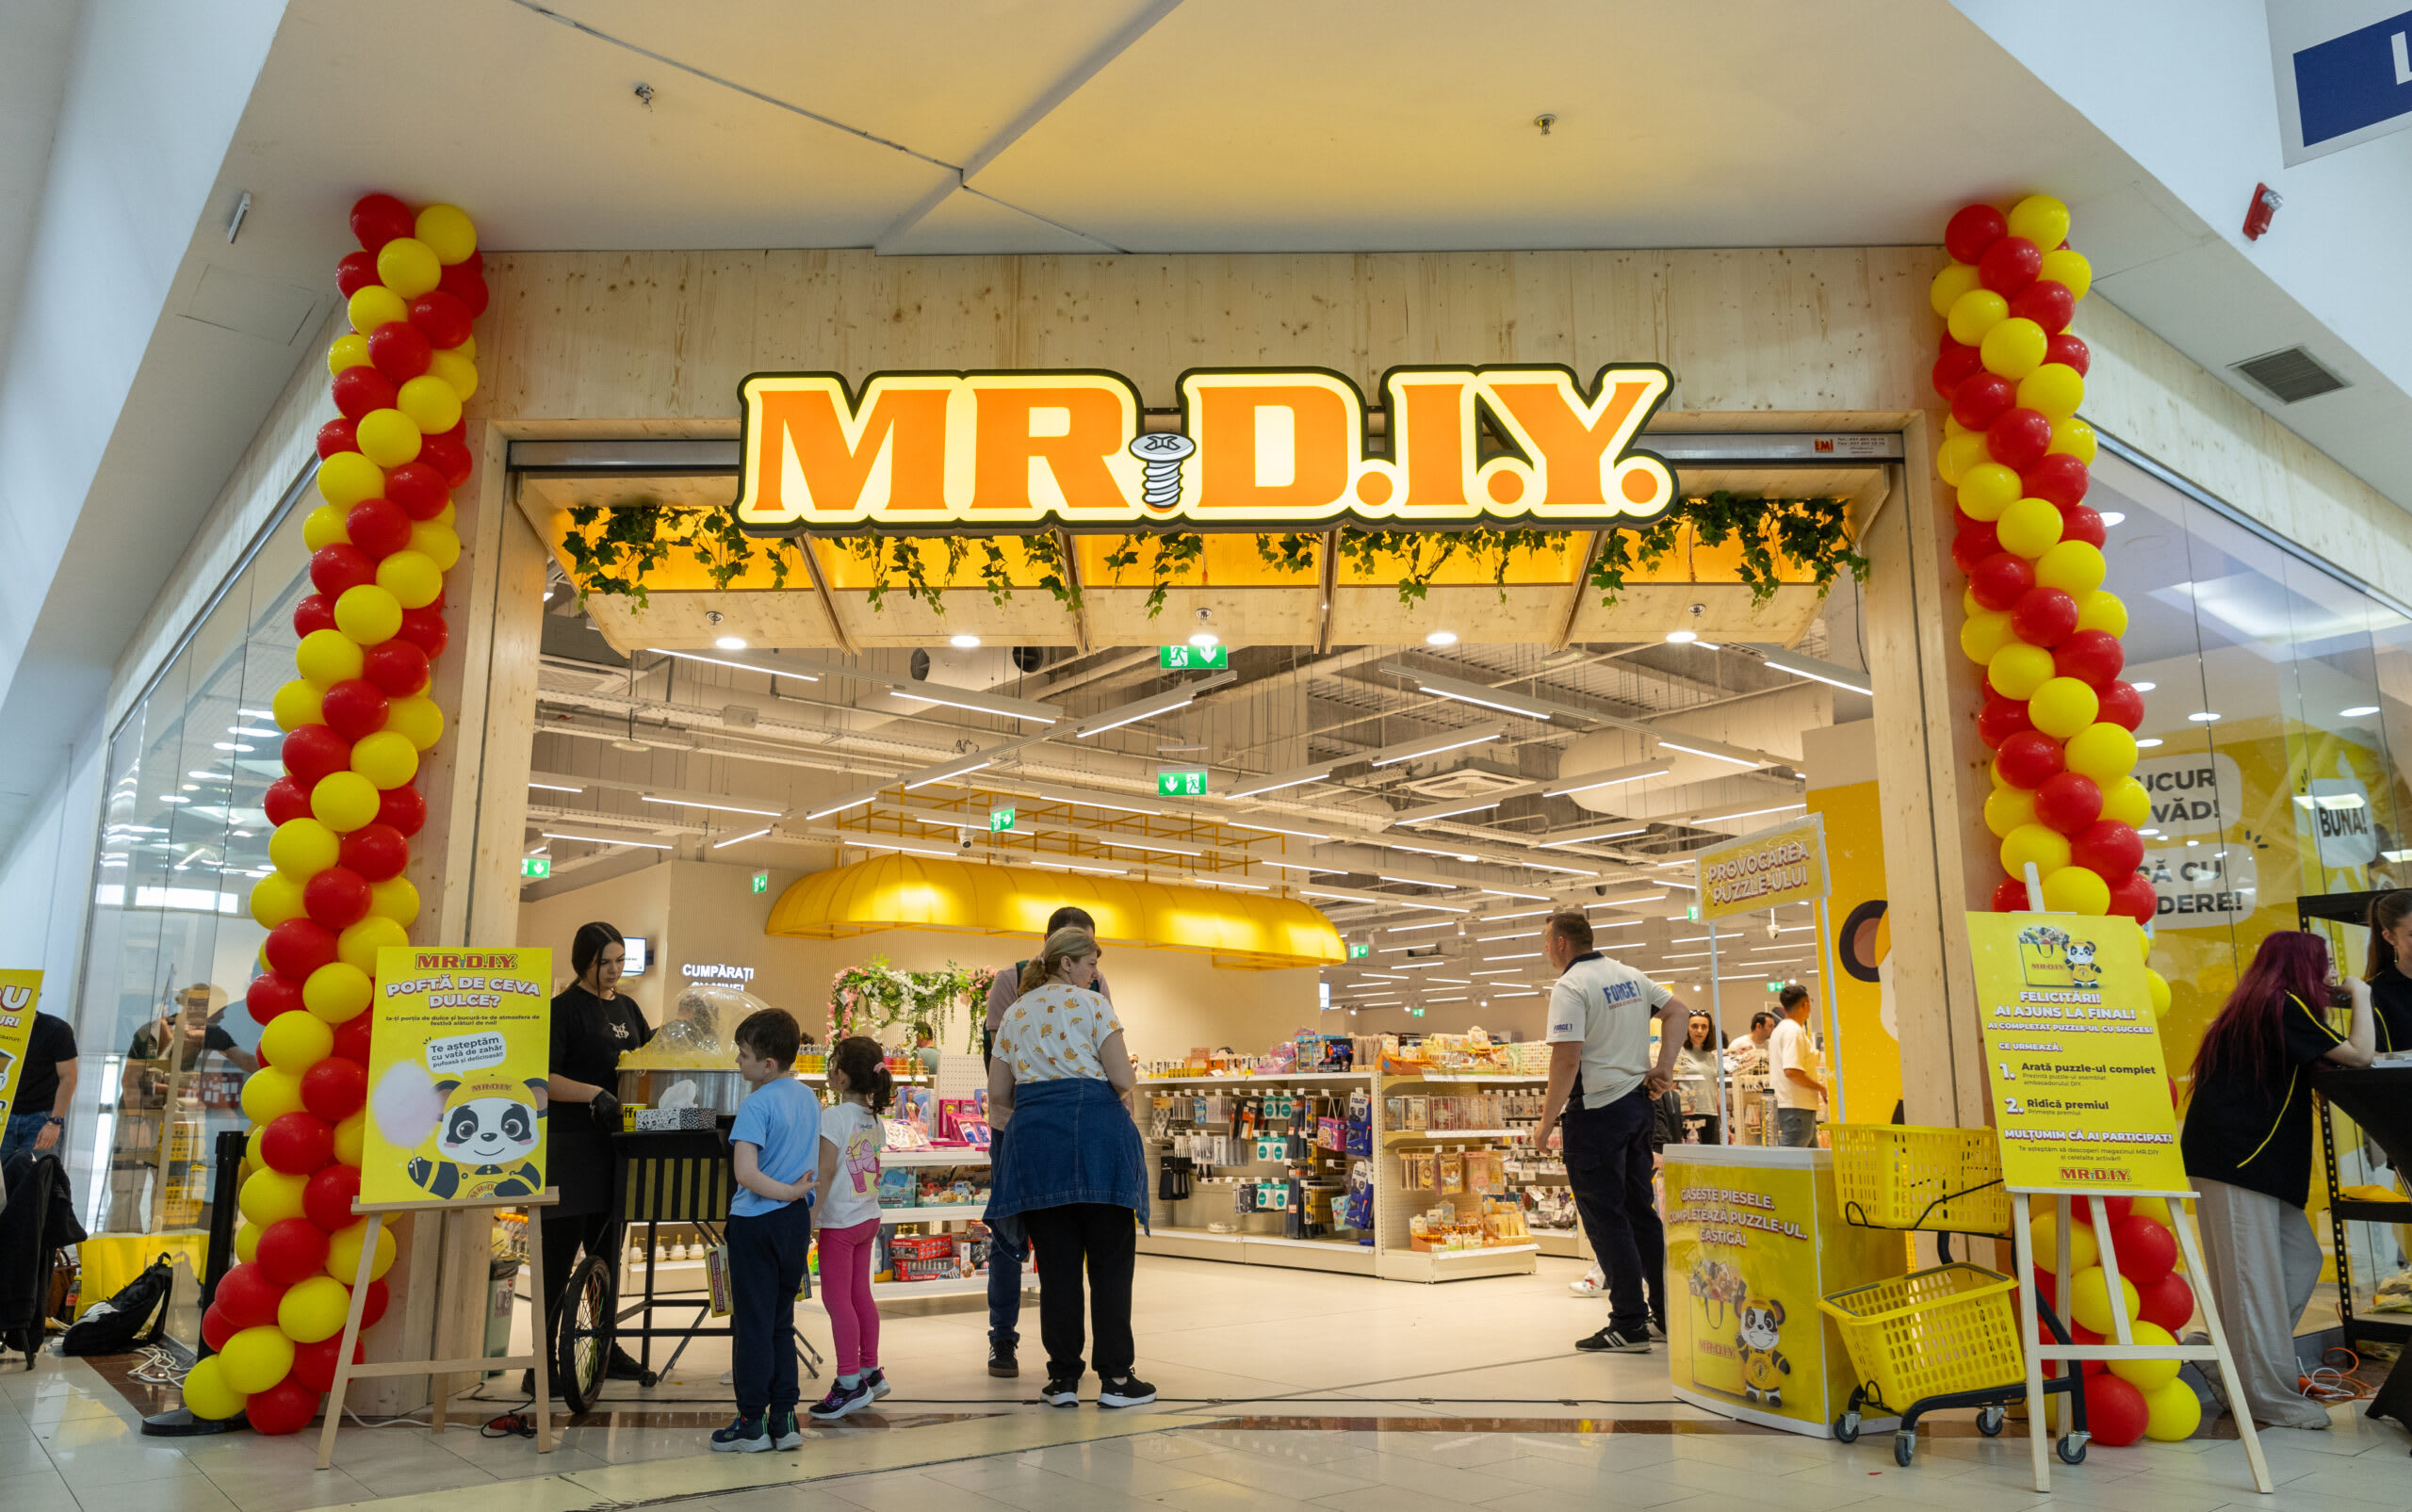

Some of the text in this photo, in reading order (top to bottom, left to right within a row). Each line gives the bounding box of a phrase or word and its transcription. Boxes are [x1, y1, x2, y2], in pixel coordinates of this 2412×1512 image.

[1708, 840, 1810, 885] PROVOCAREA
[2179, 859, 2222, 882] CU
[1713, 865, 1809, 907] PUZZLE-ULUI
[681, 963, 755, 983] CUMPĂRAȚI
[385, 974, 541, 998] POFTĂ DE CEVA
[1602, 981, 1637, 1005] FORCE
[0, 984, 33, 1012] U
[429, 994, 501, 1010] DULCE?
[2019, 991, 2101, 1005] FELICITĂRI!
[1995, 1005, 2136, 1020] AI AJUNS LA FINAL!
[1998, 1022, 2051, 1032] COMPLETAT
[2052, 1024, 2100, 1032] PUZZLE-UL
[2115, 1026, 2154, 1034] SUCCES!
[431, 1036, 499, 1053] Te așteptăm
[432, 1053, 443, 1062] cu
[445, 1050, 464, 1060] vată
[479, 1044, 503, 1054] zahăr
[1997, 1042, 2063, 1051] CE URMEAZĂ:
[432, 1058, 460, 1068] pufoasă
[1999, 1062, 2157, 1081] 1. Arată puzzle-ul complet
[2004, 1097, 2110, 1114] 2. Ridică premiul
[2004, 1129, 2174, 1144] MULȚUMIM CĂ AI PARTICIPAT!
[1680, 1187, 1776, 1210] GĂSEȘTE PIESELE.
[1669, 1207, 1808, 1241] COMPLETEAZĂ PUZZLE-UL.
[1699, 1227, 1747, 1248] CÂȘTIGĂ!
